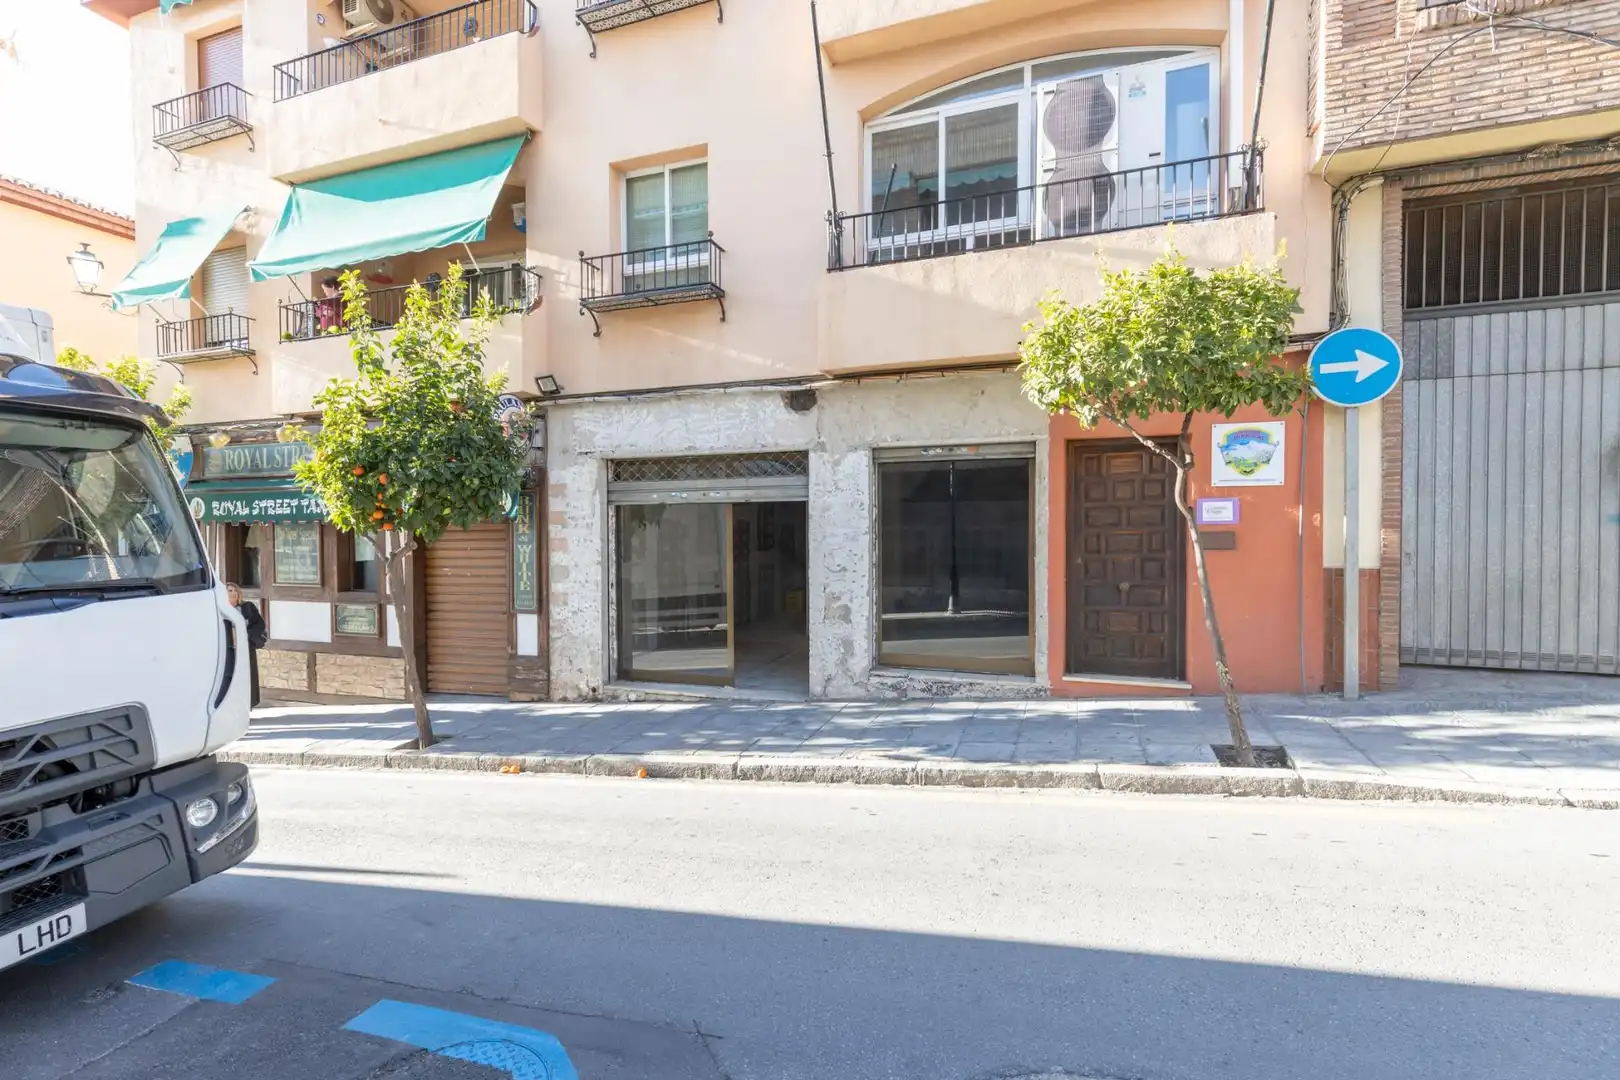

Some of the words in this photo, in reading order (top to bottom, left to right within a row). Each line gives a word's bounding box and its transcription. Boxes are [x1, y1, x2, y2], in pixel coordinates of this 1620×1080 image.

[224, 446, 271, 470] ROYAL
[273, 444, 313, 468] STRE
[211, 500, 250, 517] ROYAL
[252, 499, 299, 516] STREET
[17, 914, 72, 956] LHD
